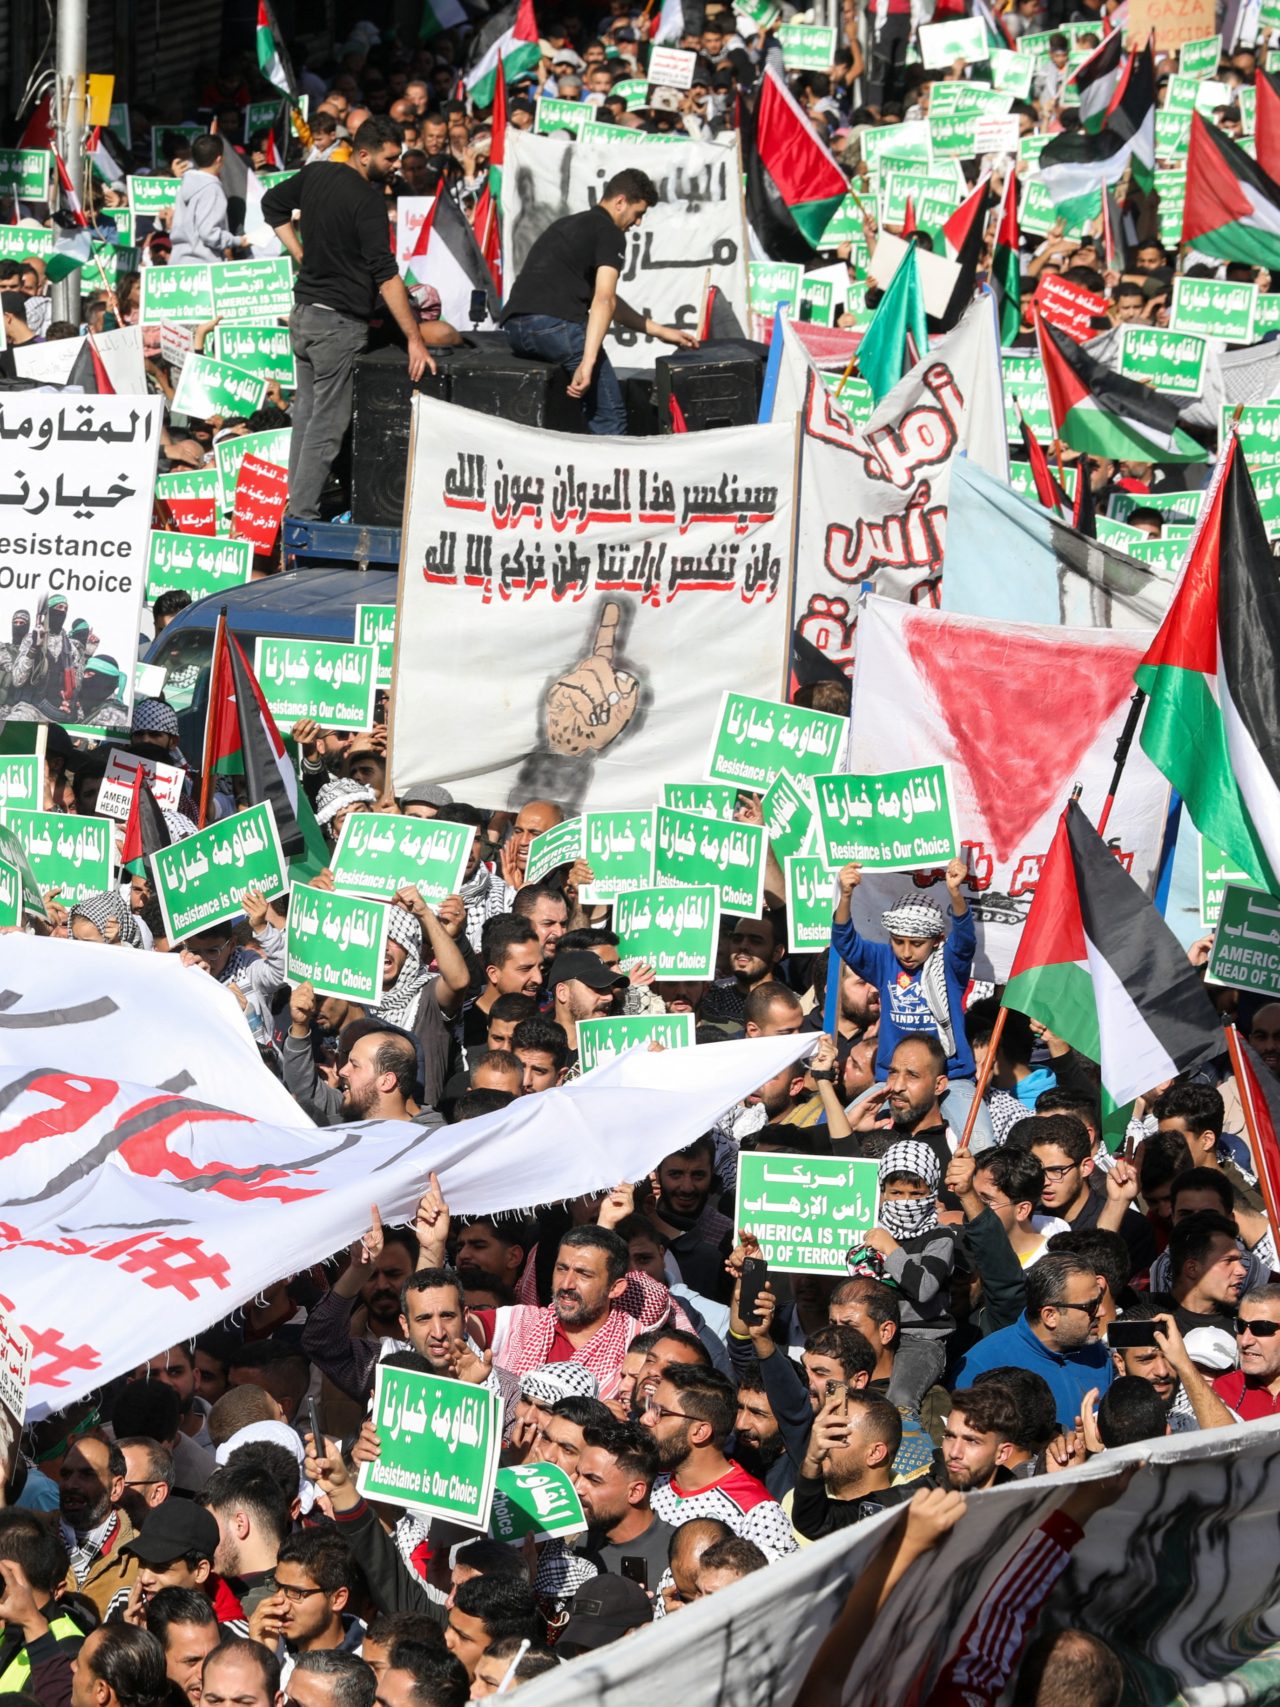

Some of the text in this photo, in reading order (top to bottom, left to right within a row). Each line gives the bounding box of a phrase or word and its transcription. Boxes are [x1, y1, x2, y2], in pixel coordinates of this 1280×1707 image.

[1130, 25, 1212, 44] GNOCIDE
[216, 293, 290, 308] AMERICA IS THE
[238, 308, 248, 316] OF
[1126, 330, 1202, 365] المقاومة خيارنا
[445, 452, 778, 531] سينكسر هذا العدوان بعون الله
[424, 531, 456, 581] لله
[743, 543, 781, 598] ولن
[48, 568, 132, 592] Choice
[266, 647, 367, 689] المقاومة خيارنا
[267, 700, 364, 720] esistance Our Choice
[727, 702, 837, 757] المقاومة خيارنا
[715, 754, 766, 780] Resistance
[822, 774, 941, 826] المقاومة خيارنا
[162, 814, 268, 893] المقاومة خيارنا
[348, 818, 461, 865] المقاومة خيارنا
[659, 816, 756, 870] المقاومة خيارنا
[830, 836, 950, 860] Resistance Our Choice
[334, 868, 384, 890] Resistance
[722, 886, 752, 907] Choice
[173, 898, 220, 931] Resistance
[291, 893, 377, 951] المقاومة خيارنا
[655, 896, 710, 937] المقاومة
[659, 951, 706, 969] Our Choice
[323, 965, 372, 991] Our Choice
[763, 1163, 854, 1190] أمريكا
[744, 1192, 870, 1222] رأس الإرهاب
[818, 1226, 833, 1245] IS
[777, 1247, 793, 1263] OF
[382, 1380, 486, 1454] المقاومة خيارنا
[371, 1459, 478, 1504] Resistance Our Choice
